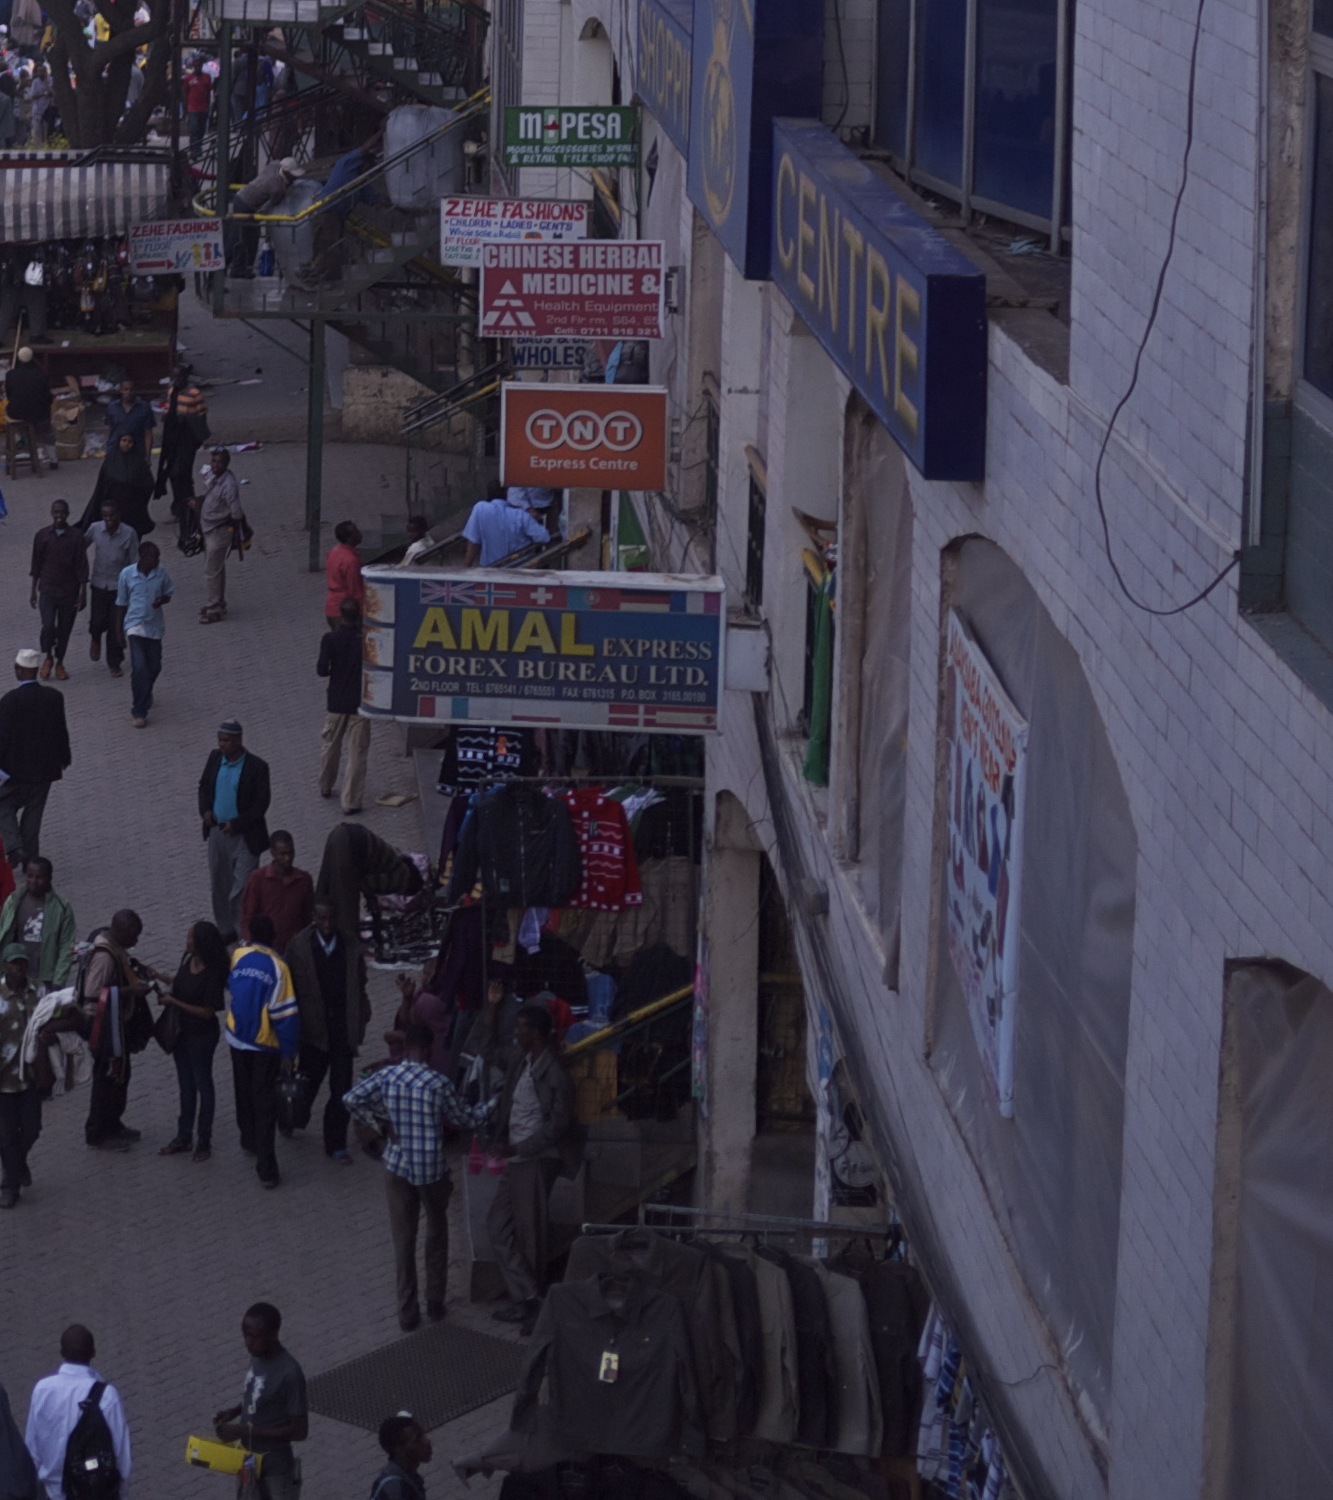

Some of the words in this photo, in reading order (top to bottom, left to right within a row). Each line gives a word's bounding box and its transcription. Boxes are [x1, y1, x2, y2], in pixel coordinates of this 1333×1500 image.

[522, 154, 557, 163] RETAIL
[445, 200, 499, 218] ZEHE
[501, 202, 585, 221] FASHIONS
[132, 223, 165, 238] ZEHE
[166, 221, 220, 235] FASHIONS
[450, 218, 492, 228] CHILDREN
[500, 220, 533, 229] LADIES
[539, 222, 573, 231] GENTS
[484, 246, 574, 269] CHINESE
[579, 246, 661, 269] HERBAL
[522, 273, 634, 295] MEDICINE
[641, 274, 661, 295] &
[776, 153, 921, 436] CENTRE
[534, 300, 580, 311] Health
[585, 300, 658, 313] Equipment
[546, 316, 567, 325] 2nd
[580, 327, 608, 336] 0711
[531, 414, 637, 447] TNT
[529, 456, 585, 472] Express
[589, 457, 639, 470] Centre
[412, 606, 594, 656] AMAL
[602, 638, 712, 660] EXPRESS
[407, 654, 509, 678] FOREX
[517, 657, 639, 684] BUREAU
[649, 665, 709, 687] LTD.
[410, 679, 430, 692] 2ND
[431, 681, 460, 693] FLOOR
[638, 689, 658, 700] BOX
